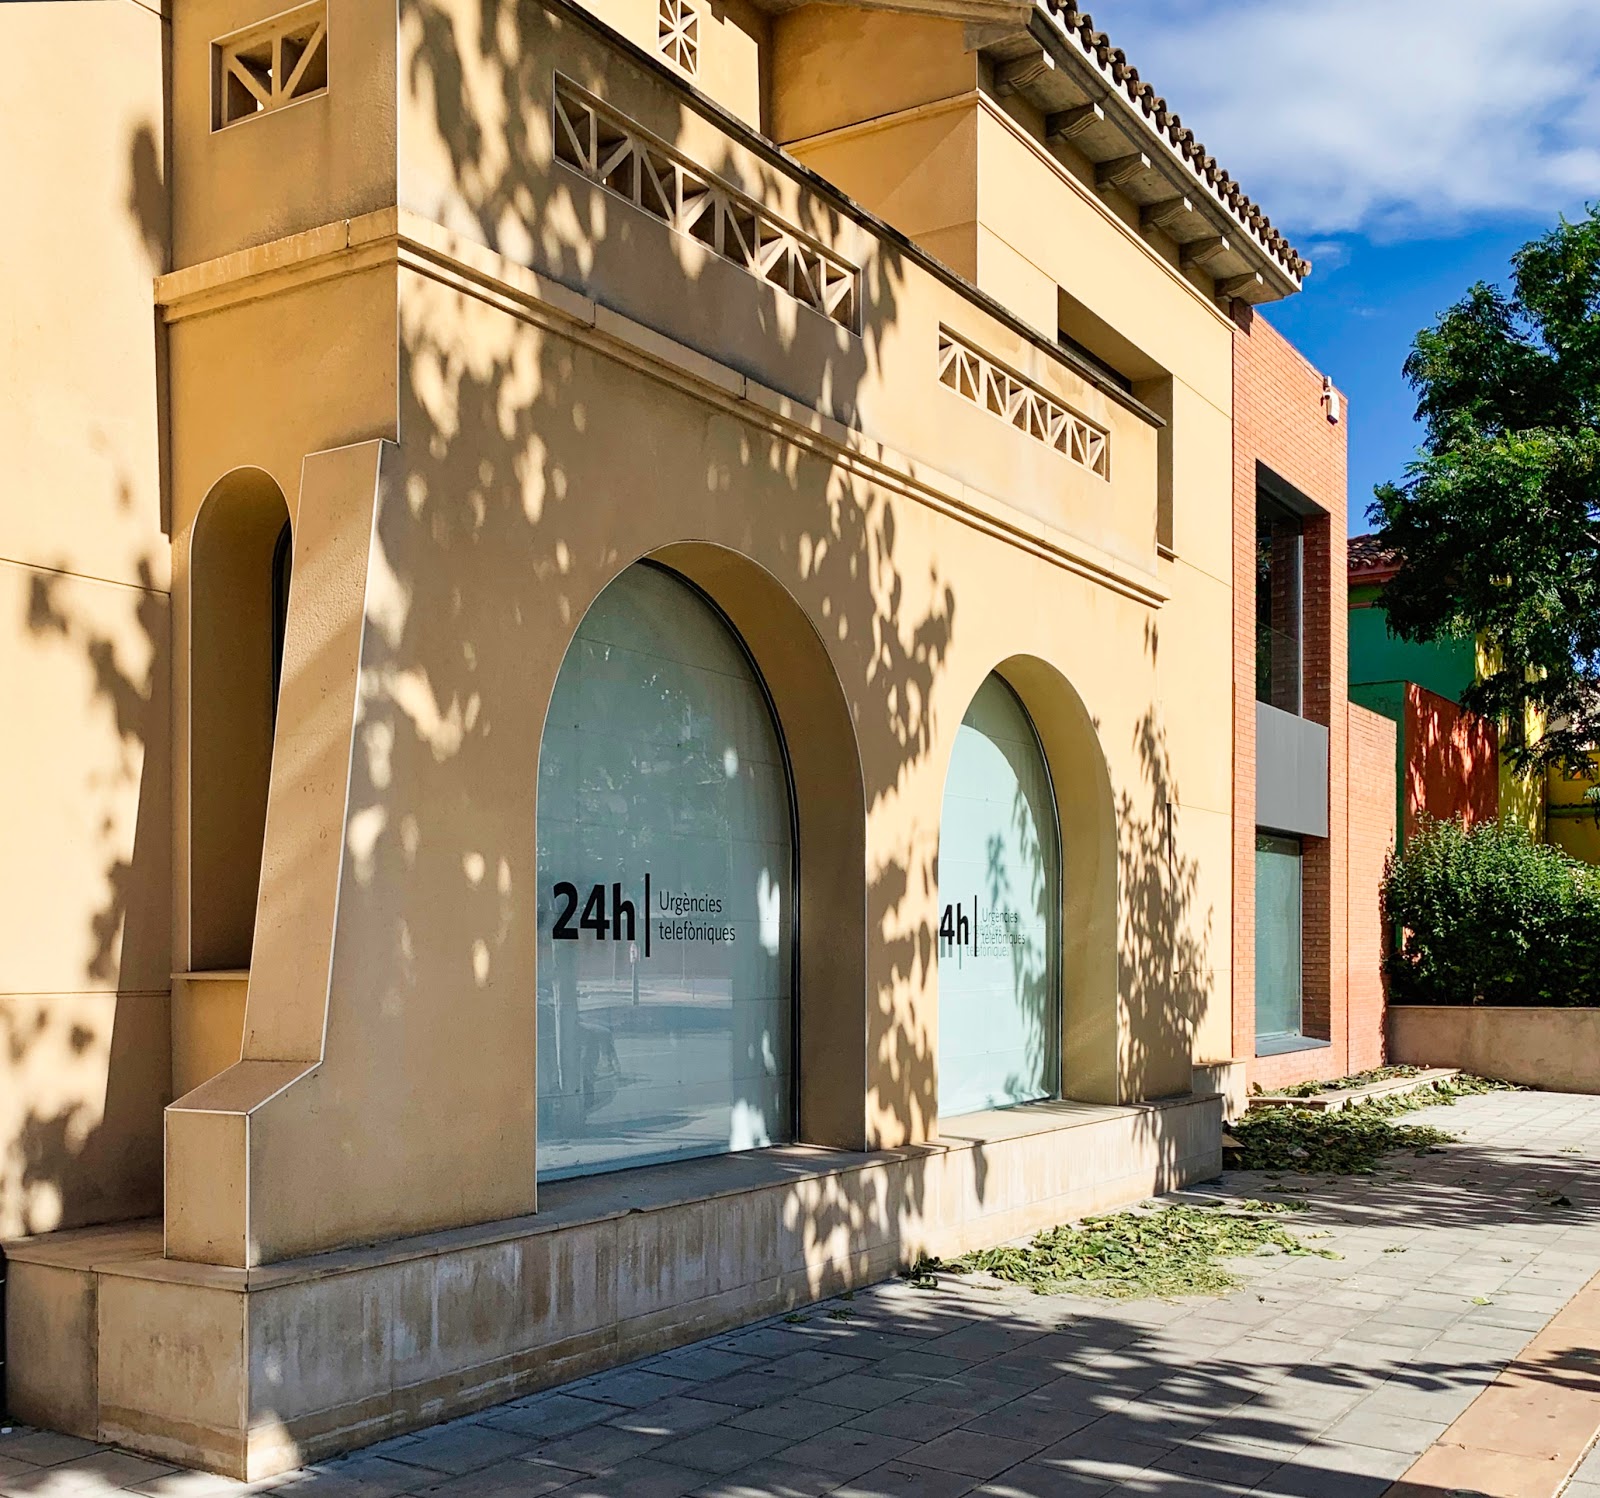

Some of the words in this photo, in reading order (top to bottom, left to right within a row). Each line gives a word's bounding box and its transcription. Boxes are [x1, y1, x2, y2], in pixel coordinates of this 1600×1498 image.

[552, 881, 636, 941] 24h
[659, 890, 723, 915] Urgències
[659, 921, 736, 944] telefòniques
[939, 902, 970, 946] 4h
